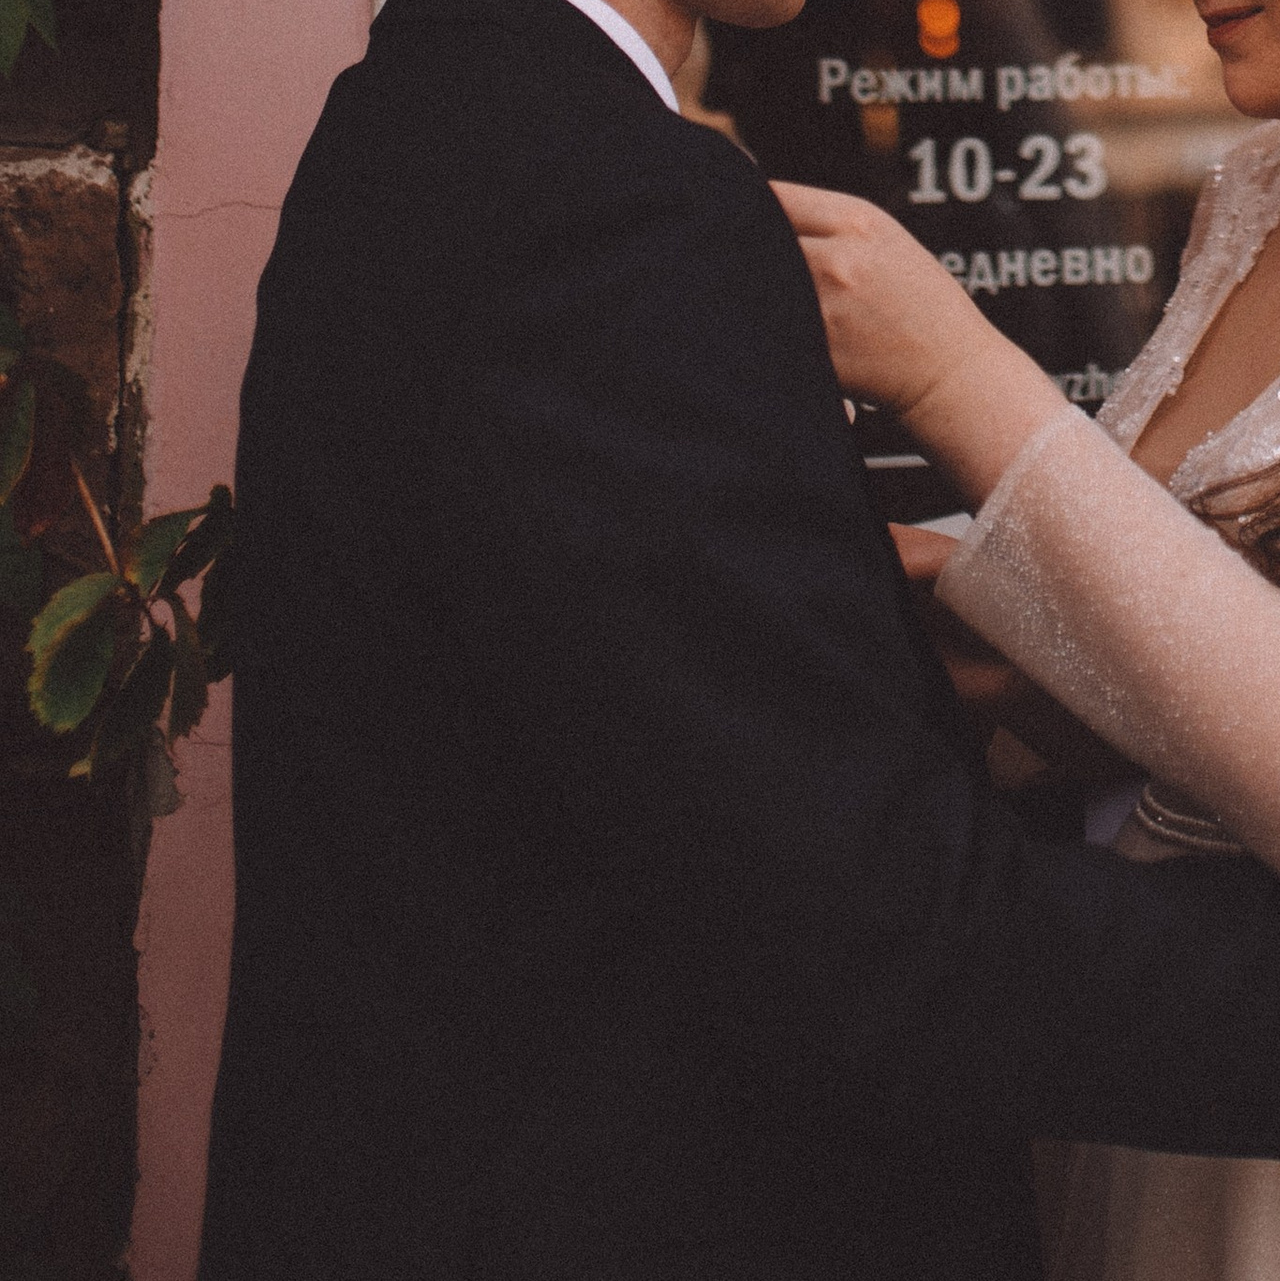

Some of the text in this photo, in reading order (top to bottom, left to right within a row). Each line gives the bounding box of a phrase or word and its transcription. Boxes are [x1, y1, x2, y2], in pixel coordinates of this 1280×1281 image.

[817, 57, 985, 104] Режим
[907, 133, 1108, 204] 10-23
[940, 245, 1156, 295] едневно
